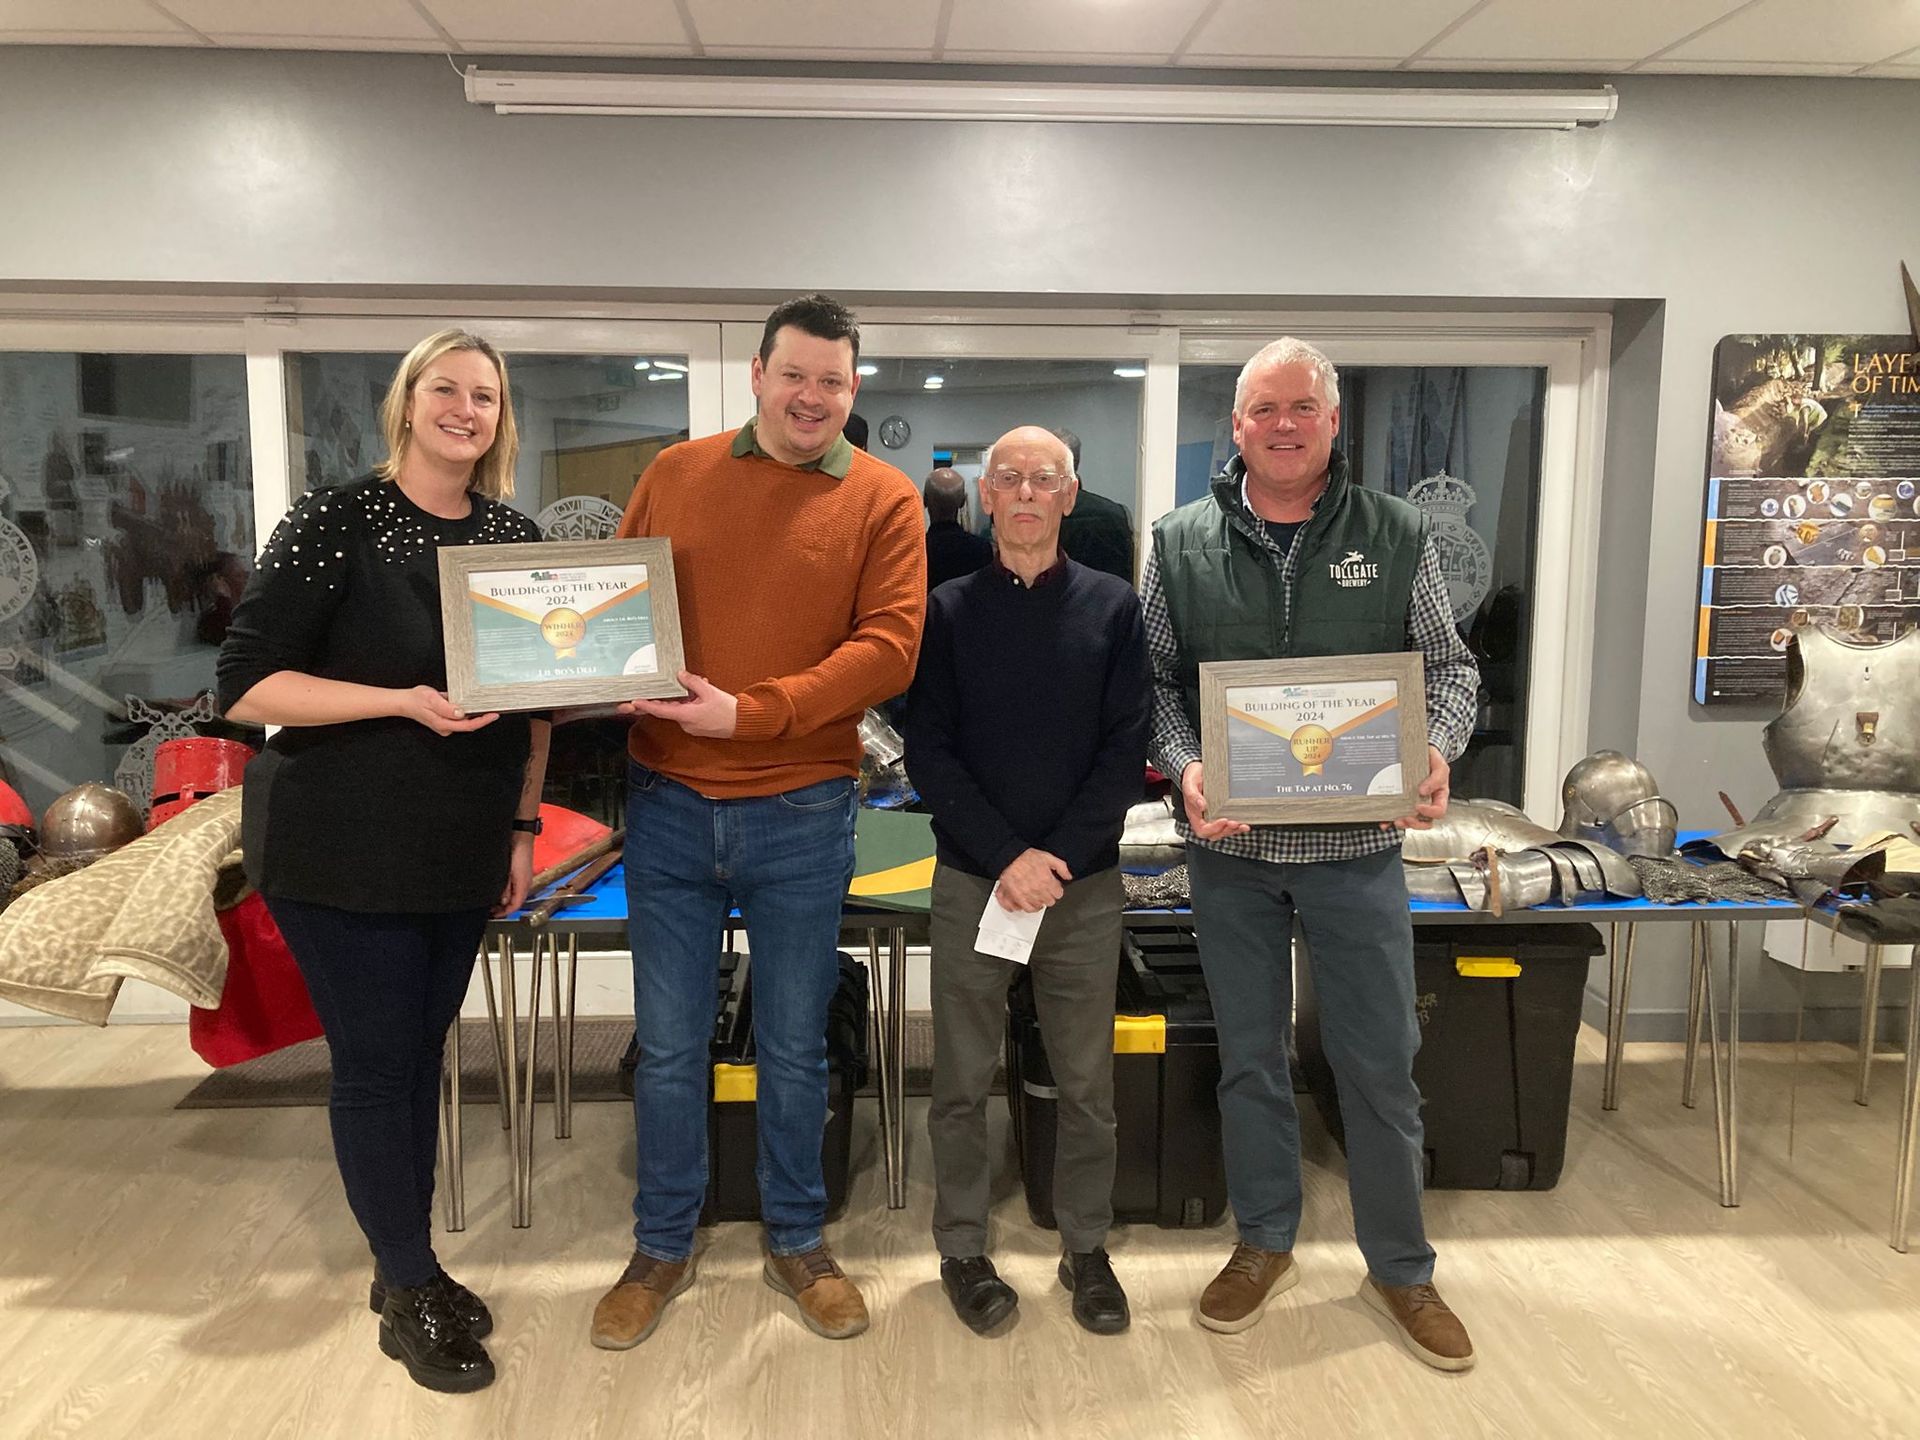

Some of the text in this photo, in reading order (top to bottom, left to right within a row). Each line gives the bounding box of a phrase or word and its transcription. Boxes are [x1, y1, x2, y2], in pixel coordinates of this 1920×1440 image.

[1852, 375, 1883, 394] OF
[1329, 563, 1379, 579] TOLLGATE
[1341, 579, 1367, 587] BREWERY
[491, 581, 628, 597] BUILDING OF THE YEAR
[546, 595, 575, 606] 2024
[1245, 697, 1376, 712] BUILDING OF THE YEAR
[1296, 711, 1325, 722] 2024
[1293, 737, 1330, 745] RUNNER
[1276, 785, 1293, 793] THE
[1294, 784, 1310, 793] TAP
[1341, 783, 1353, 791] 76
